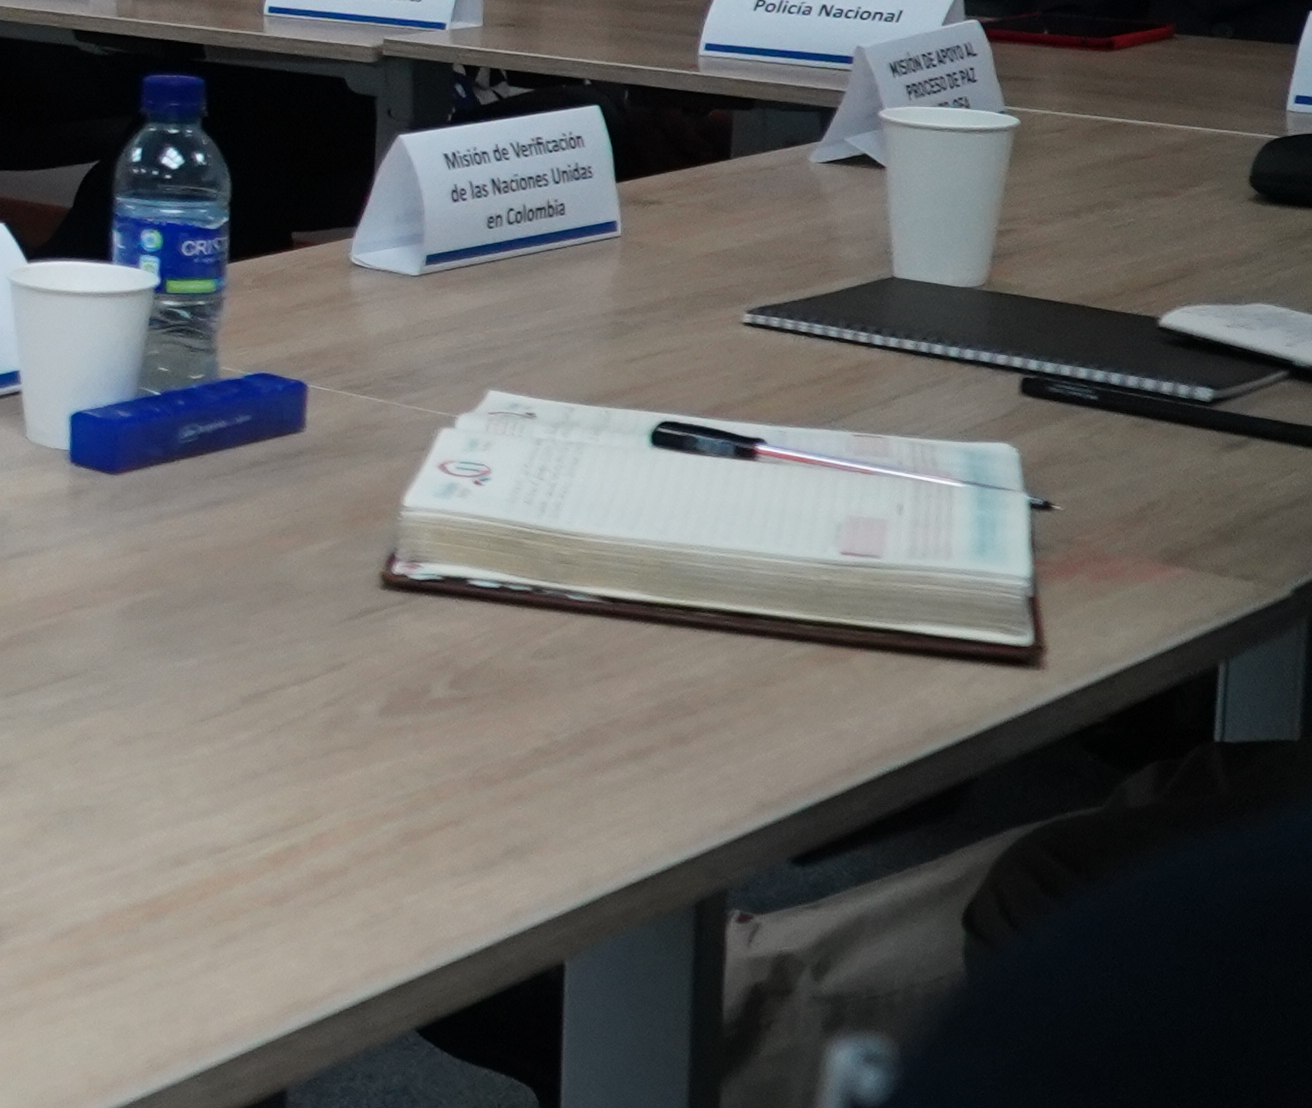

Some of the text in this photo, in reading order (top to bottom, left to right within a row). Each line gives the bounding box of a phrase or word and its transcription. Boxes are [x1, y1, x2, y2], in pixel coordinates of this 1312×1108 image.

[817, 3, 904, 23] Nacional
[921, 52, 937, 69] DE
[945, 72, 961, 89] DE
[958, 67, 978, 85] PAZ
[442, 132, 586, 171] Misión de Verificación
[450, 163, 594, 204] de las Naciones Unidas
[486, 198, 566, 230] en Colombia
